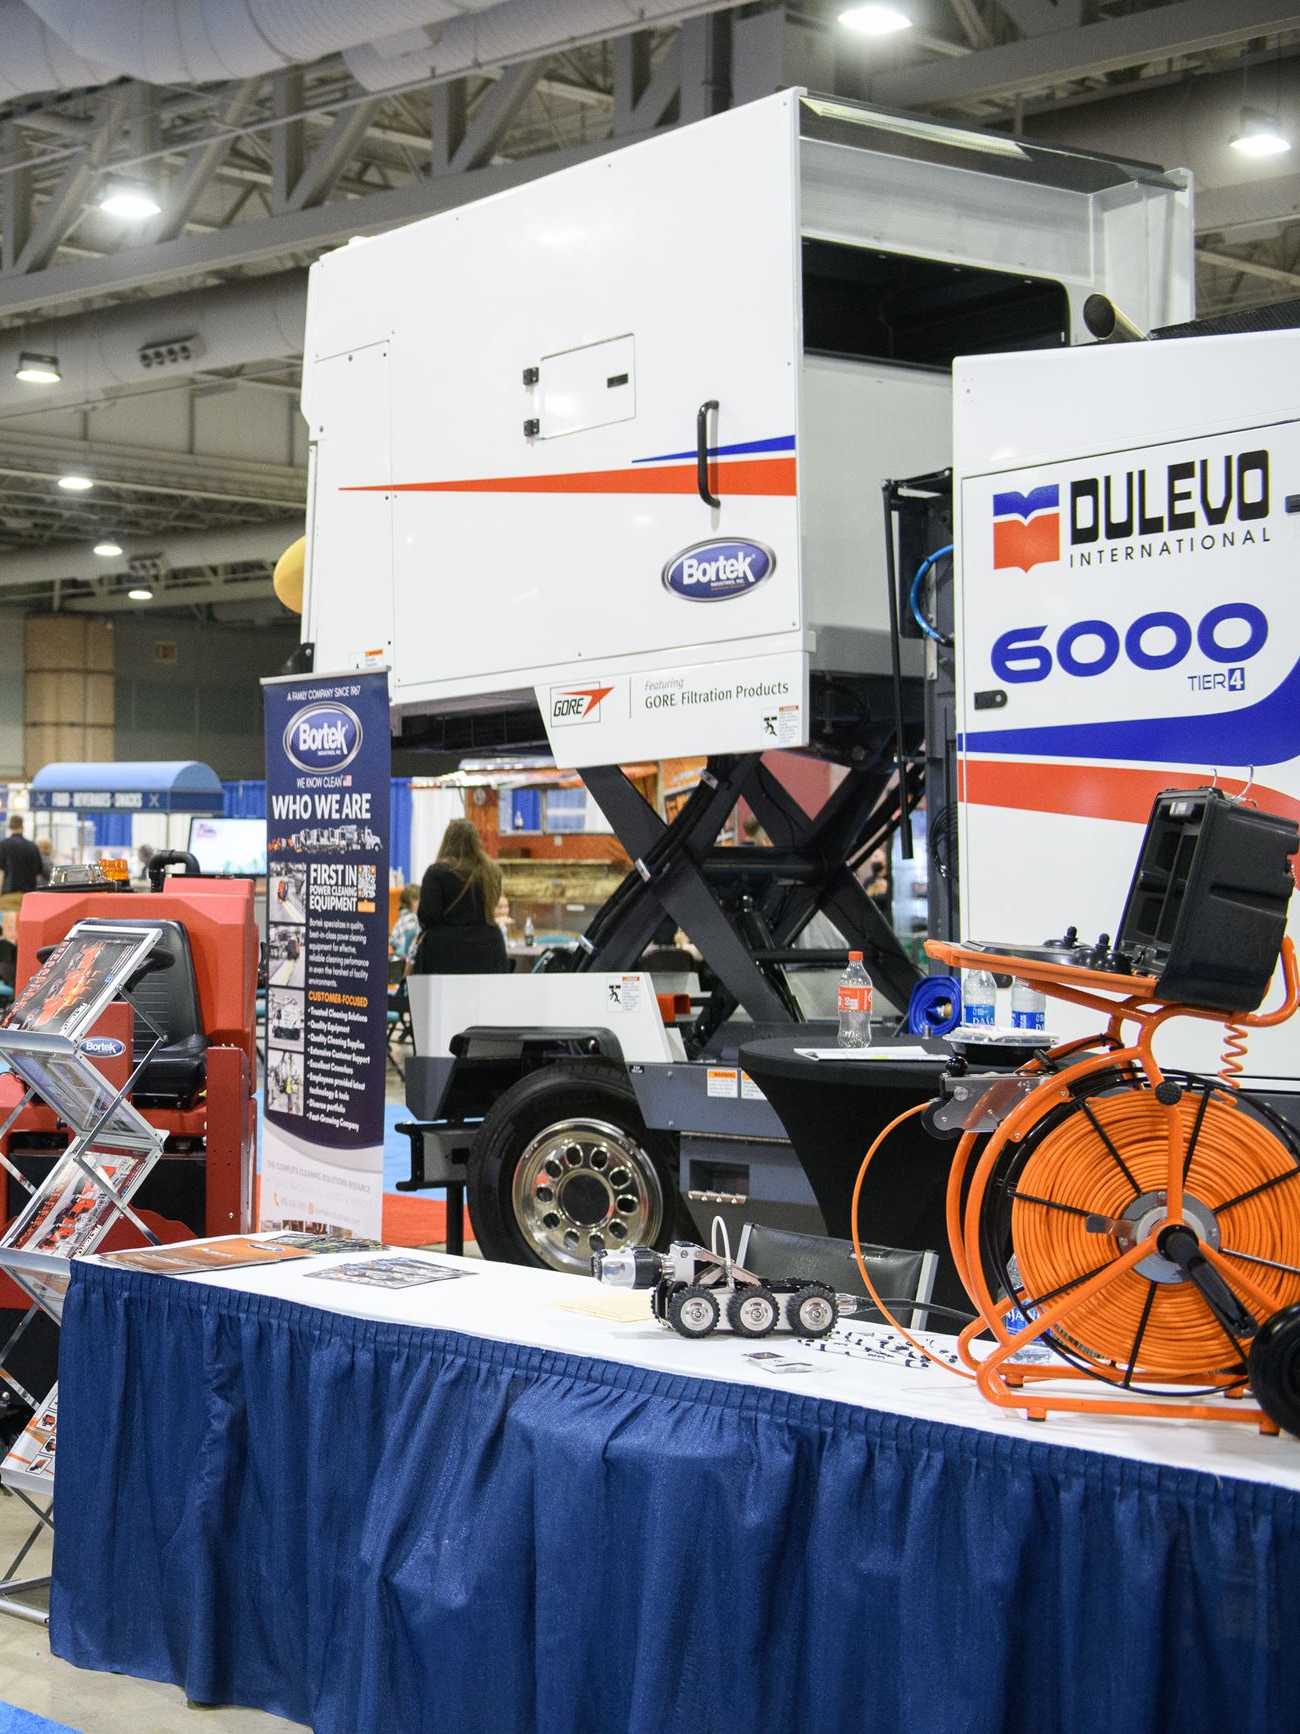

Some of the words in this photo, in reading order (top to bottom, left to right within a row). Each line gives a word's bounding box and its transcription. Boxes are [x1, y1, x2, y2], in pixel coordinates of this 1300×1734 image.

[1071, 449, 1270, 545] DULEVO
[1070, 527, 1271, 568] INTERNATIONAL
[683, 552, 755, 585] Bortek
[991, 602, 1269, 684] 6000
[645, 677, 684, 692] Featuring
[292, 690, 308, 700] FAMILY
[308, 688, 334, 700] COMPANY
[334, 686, 350, 698] SINCE
[681, 689, 733, 706] Filtration
[736, 682, 789, 698] Products
[553, 697, 585, 717] GORE
[300, 720, 348, 755] Bortek
[297, 777, 306, 789] WE
[306, 776, 322, 788] KNOW
[323, 775, 342, 788] CLEAN
[272, 794, 312, 820] WHO
[314, 794, 340, 820] WE
[342, 793, 372, 820] ARE
[310, 863, 344, 885] FIRST
[346, 864, 357, 886] IN
[310, 885, 330, 897] POWER
[331, 886, 357, 898] CLEANING
[309, 896, 358, 912] EQUIPMENT
[310, 918, 323, 927] Bortek
[309, 930, 336, 940] best-in-class
[337, 933, 349, 944] power
[350, 933, 367, 945] cleaning
[309, 942, 332, 953] equipment
[309, 954, 325, 963] reliable
[326, 954, 343, 966] cleaning
[308, 990, 368, 1008] CUSTOMER-FOCUSED
[328, 1008, 348, 1022] Cleaning
[310, 1021, 327, 1032] Quality
[327, 1023, 350, 1034] Equipment
[86, 1042, 116, 1054] Bortek
[310, 1034, 327, 1046] Quality
[328, 1036, 347, 1048] Cleaning
[347, 1038, 365, 1051] Supplies
[310, 1060, 330, 1070] Excellent
[332, 1050, 352, 1061] Customer
[352, 1053, 370, 1065] Support
[310, 1074, 334, 1086] Employees
[310, 1086, 334, 1100] technology
[339, 1090, 350, 1101] tools
[309, 1100, 326, 1110] Diverse
[326, 1102, 346, 1114] portfolio
[340, 1118, 360, 1132] Company
